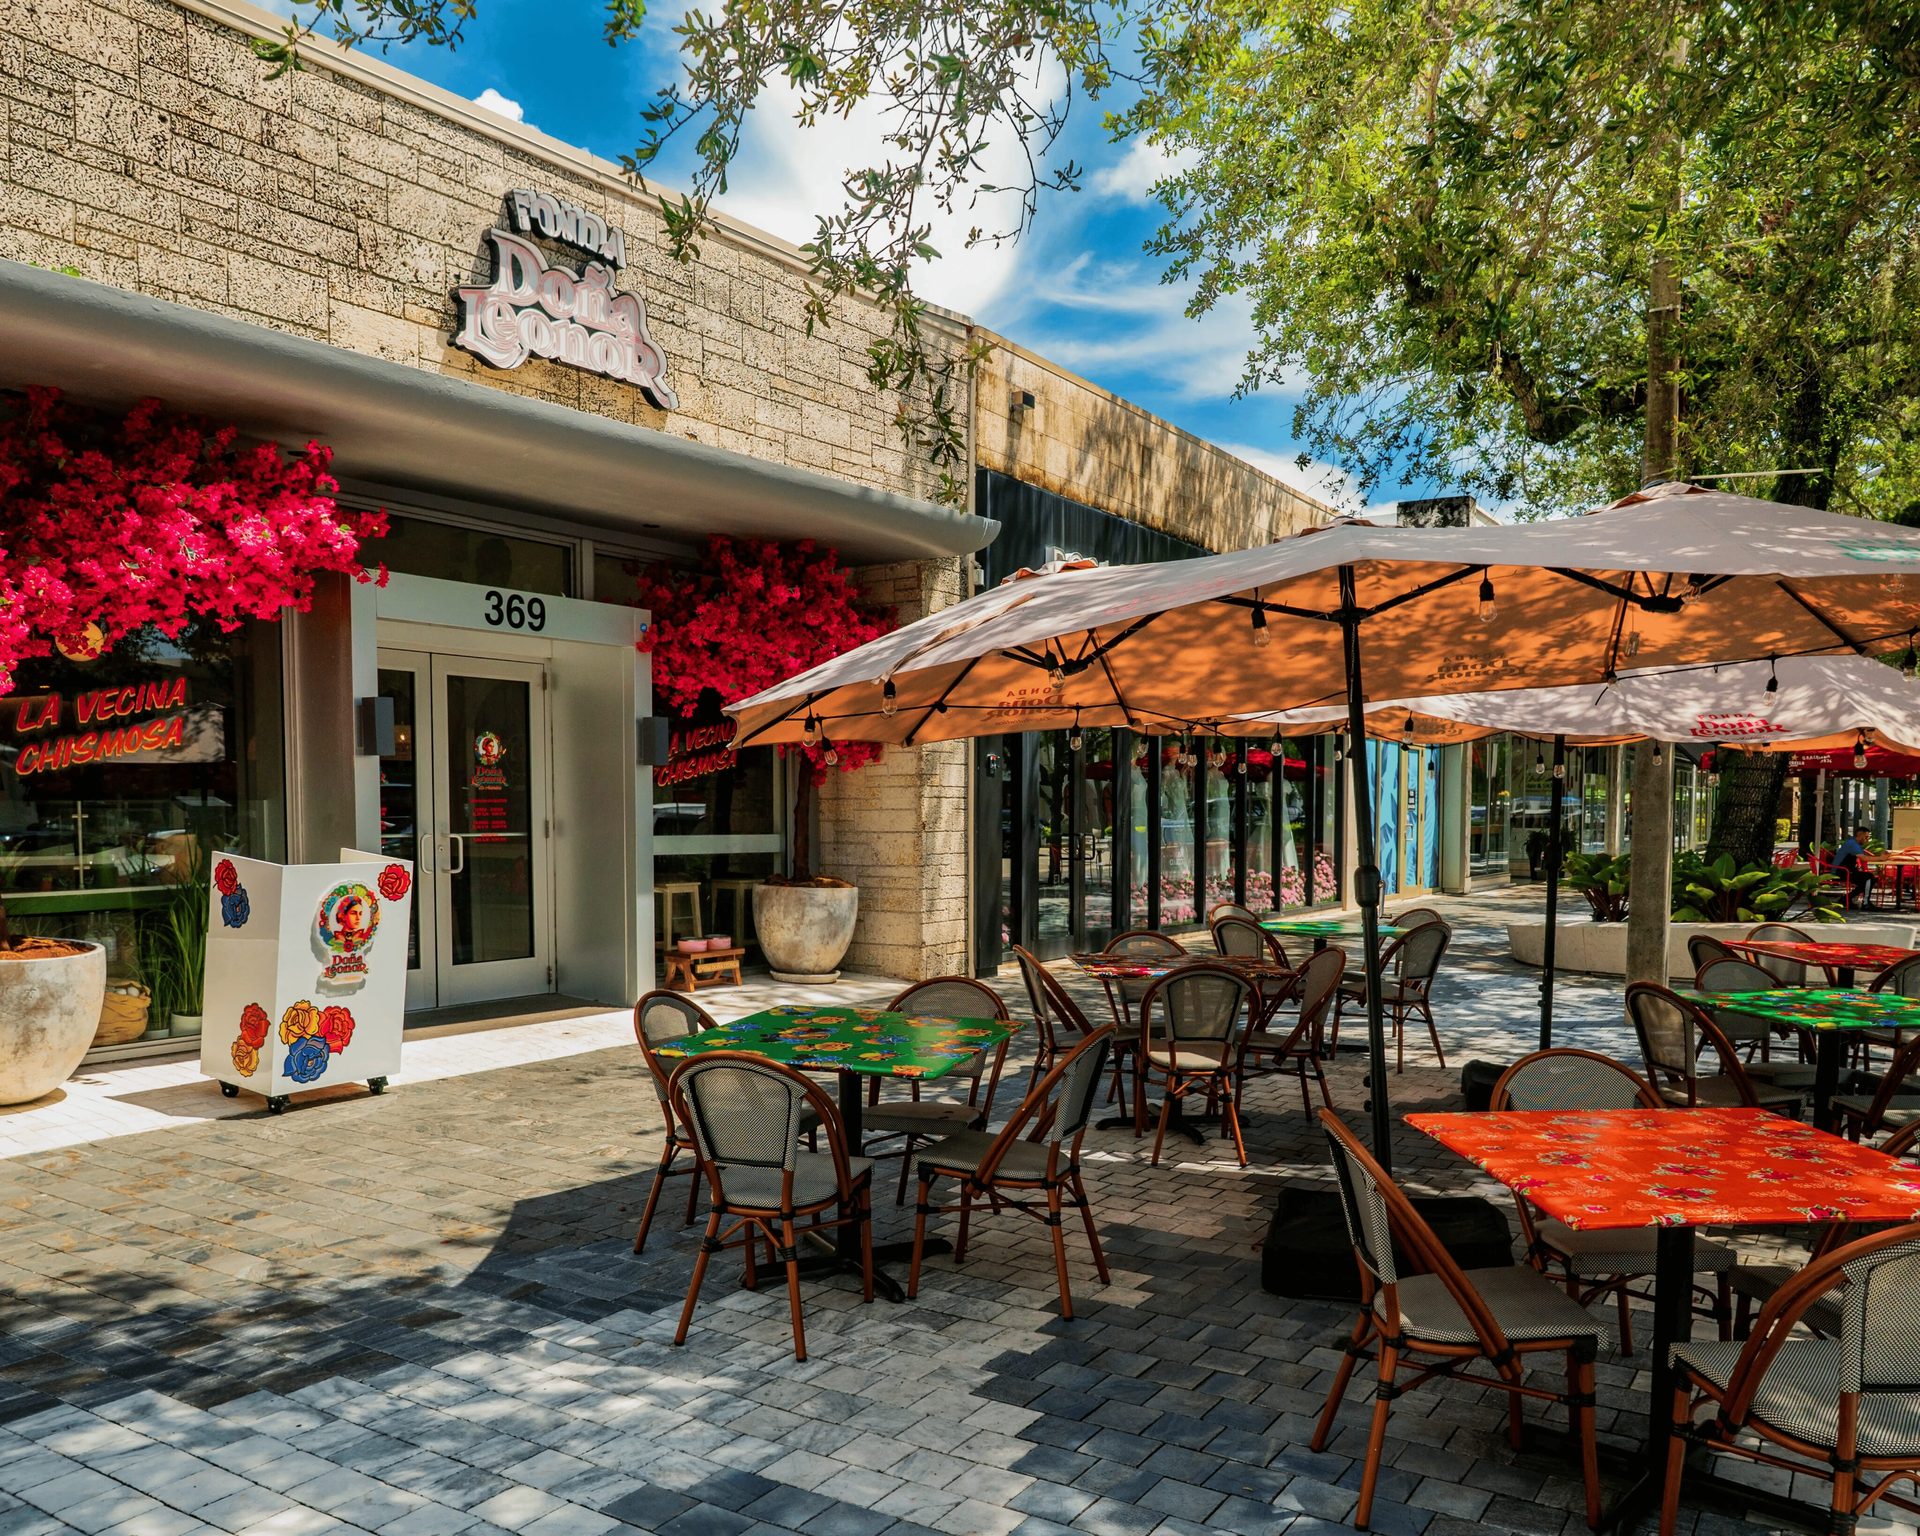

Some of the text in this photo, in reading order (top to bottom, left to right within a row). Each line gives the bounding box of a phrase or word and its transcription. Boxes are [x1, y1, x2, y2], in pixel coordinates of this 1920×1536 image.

[512, 188, 626, 269] FONDA
[491, 228, 647, 339] Doña
[484, 590, 546, 632] 369
[16, 676, 187, 732] LA VECINA
[1696, 718, 1769, 730] Doña
[1697, 712, 1757, 720] FONDA
[15, 717, 185, 776] CHISMOSA
[658, 748, 737, 787] CHISMOSA
[331, 953, 363, 967] Doña
